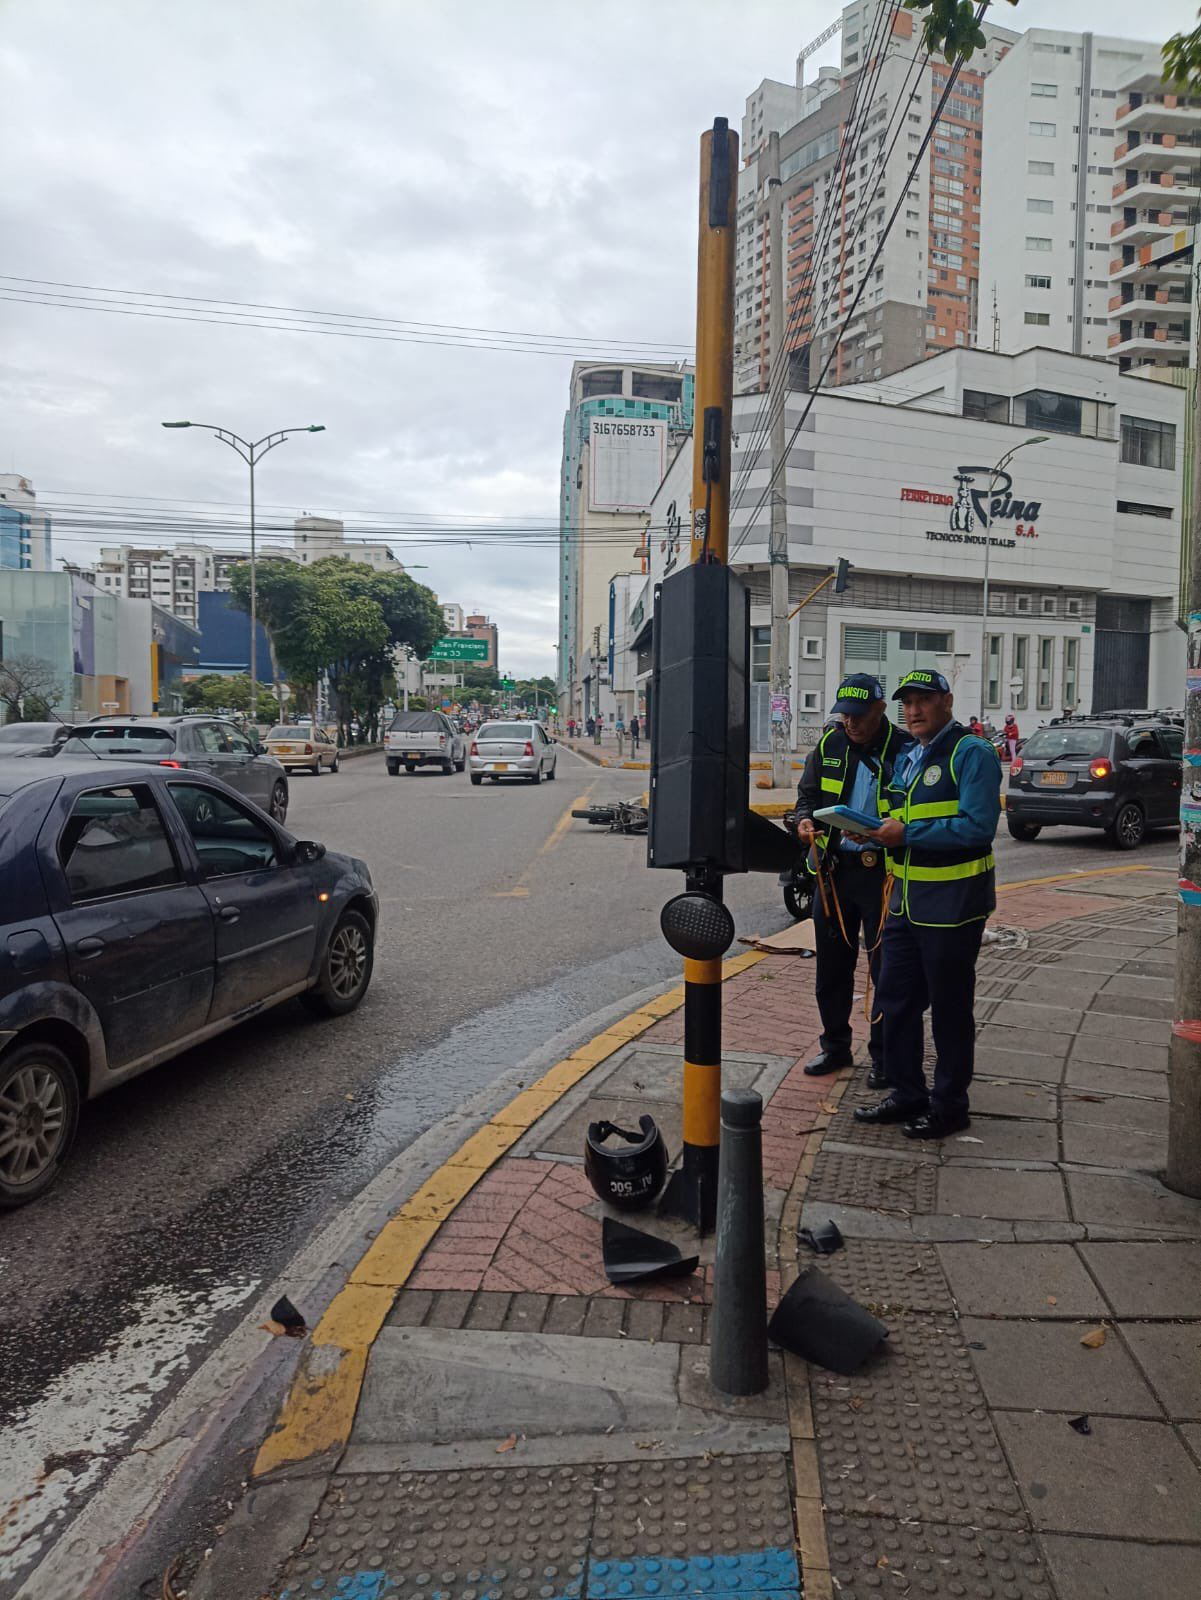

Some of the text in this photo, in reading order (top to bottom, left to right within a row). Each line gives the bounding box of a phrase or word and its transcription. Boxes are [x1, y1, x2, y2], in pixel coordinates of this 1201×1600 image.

[593, 422, 655, 437] 3167658733
[957, 466, 1042, 528] Reina
[925, 530, 963, 543] TECNICOS
[1015, 524, 1039, 538] S.A.
[438, 641, 452, 649] San
